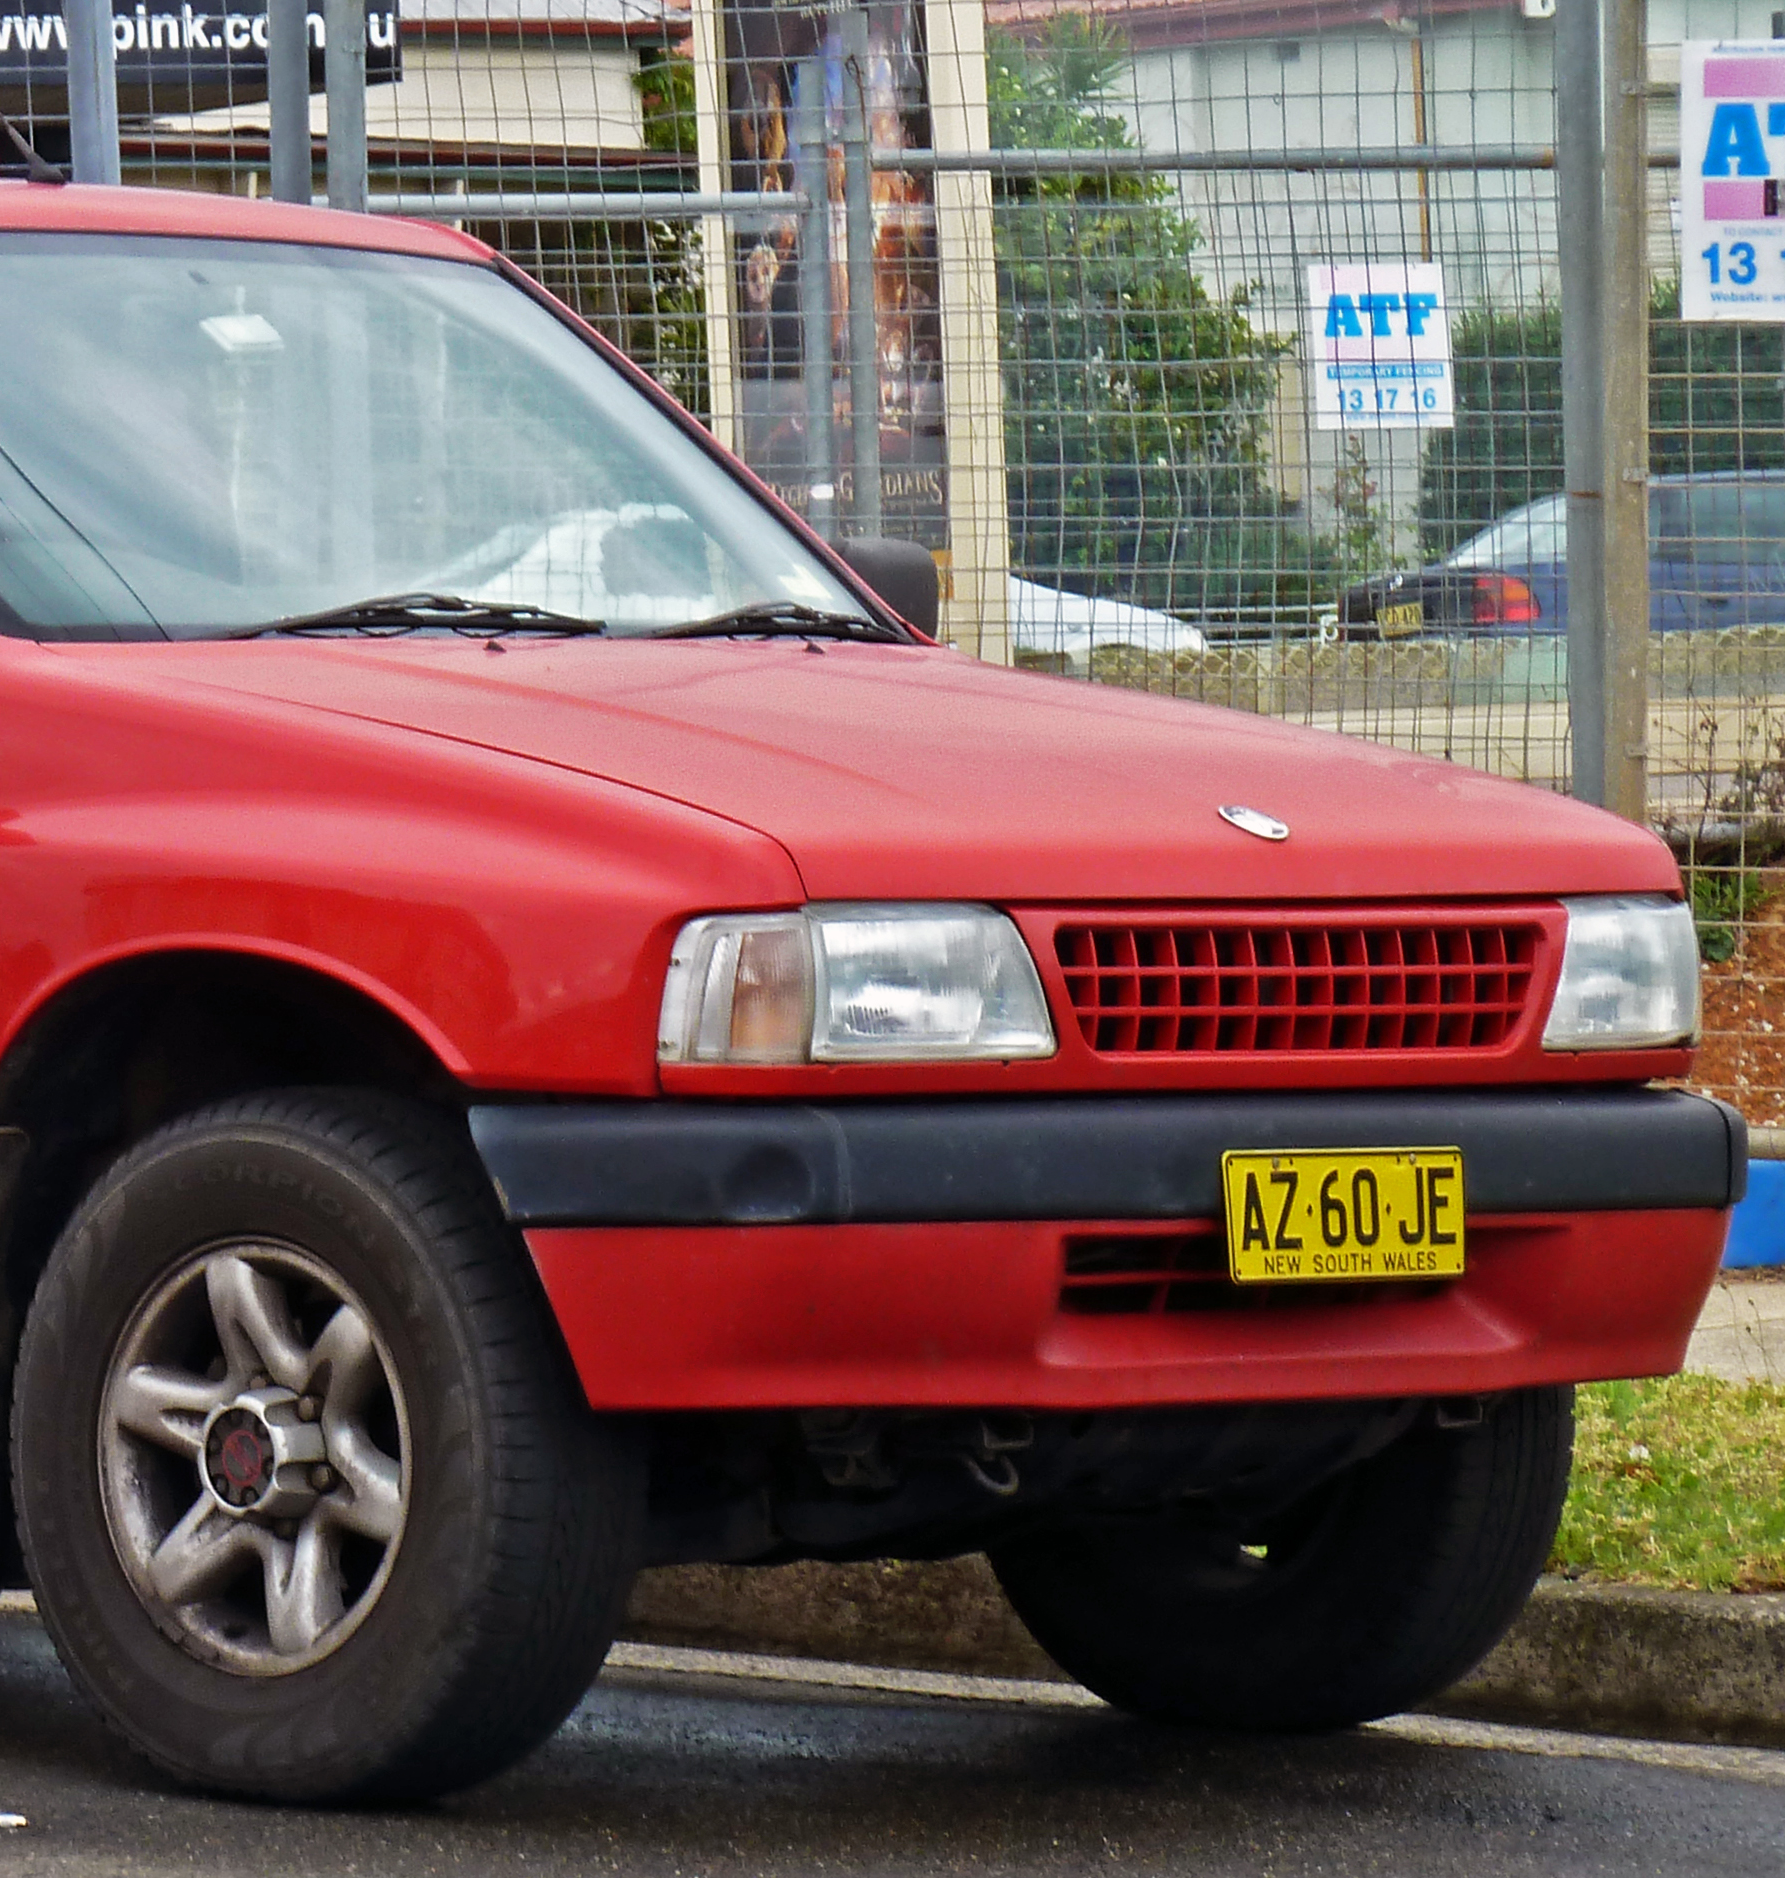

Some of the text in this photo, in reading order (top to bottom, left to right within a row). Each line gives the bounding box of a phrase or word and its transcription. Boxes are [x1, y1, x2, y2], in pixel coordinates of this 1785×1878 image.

[1701, 242, 1757, 286] 13
[1325, 293, 1438, 337] ATF
[1338, 389, 1363, 411] 13
[1264, 1252, 1437, 1274] NEW SOUTH WALES
